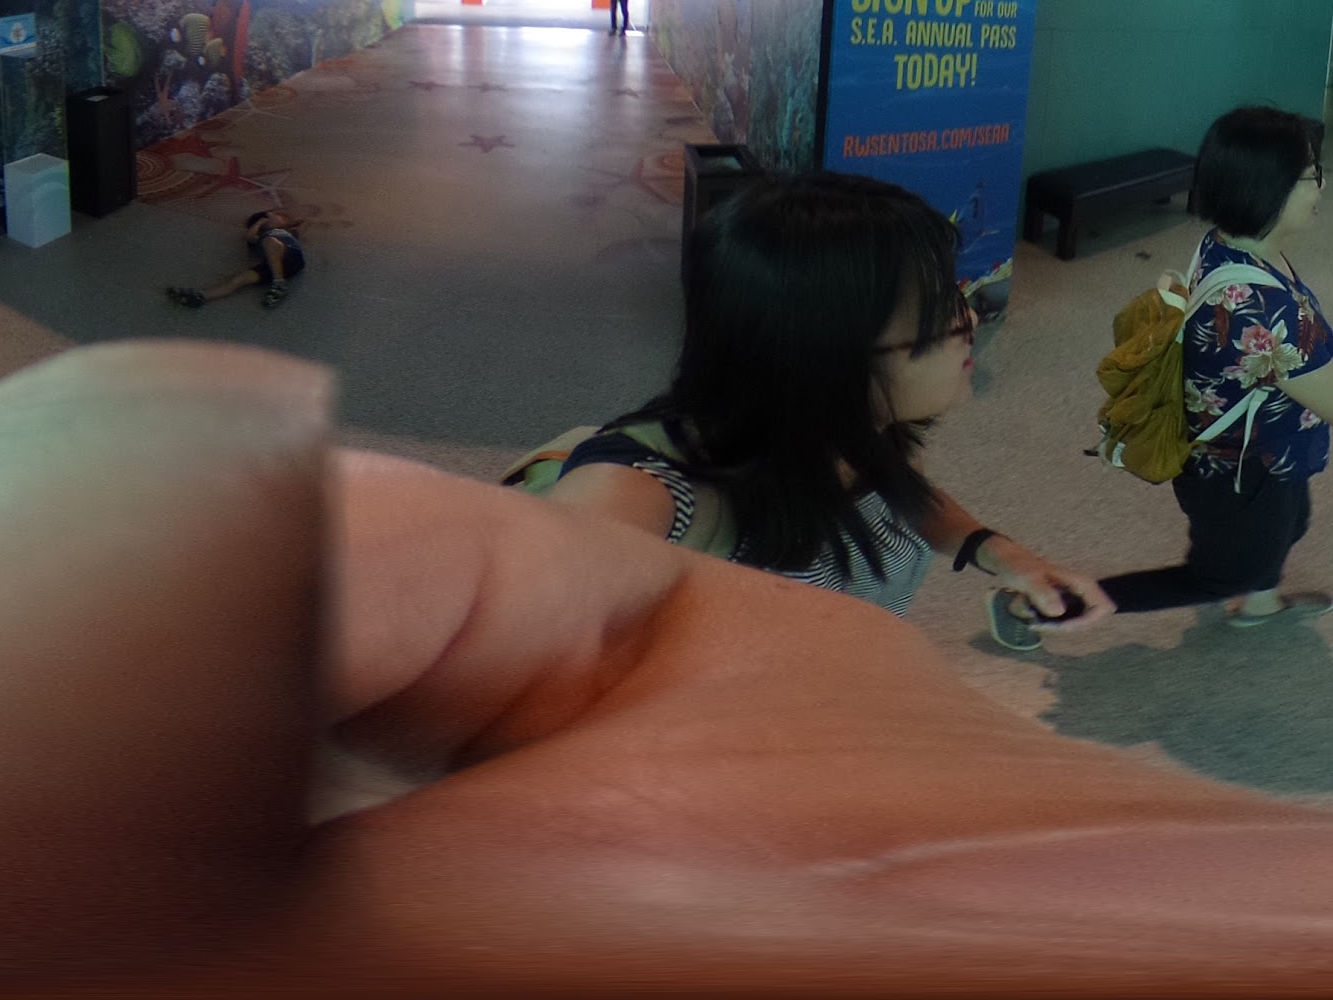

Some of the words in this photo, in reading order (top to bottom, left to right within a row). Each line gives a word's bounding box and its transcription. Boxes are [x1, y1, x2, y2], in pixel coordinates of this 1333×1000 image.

[974, 0, 994, 18] FOR
[997, 0, 1018, 18] OUR
[850, 16, 898, 46] S.E.A.
[905, 19, 974, 48] ANNUAL
[980, 23, 1017, 49] PASS
[893, 52, 978, 90] TODAY!
